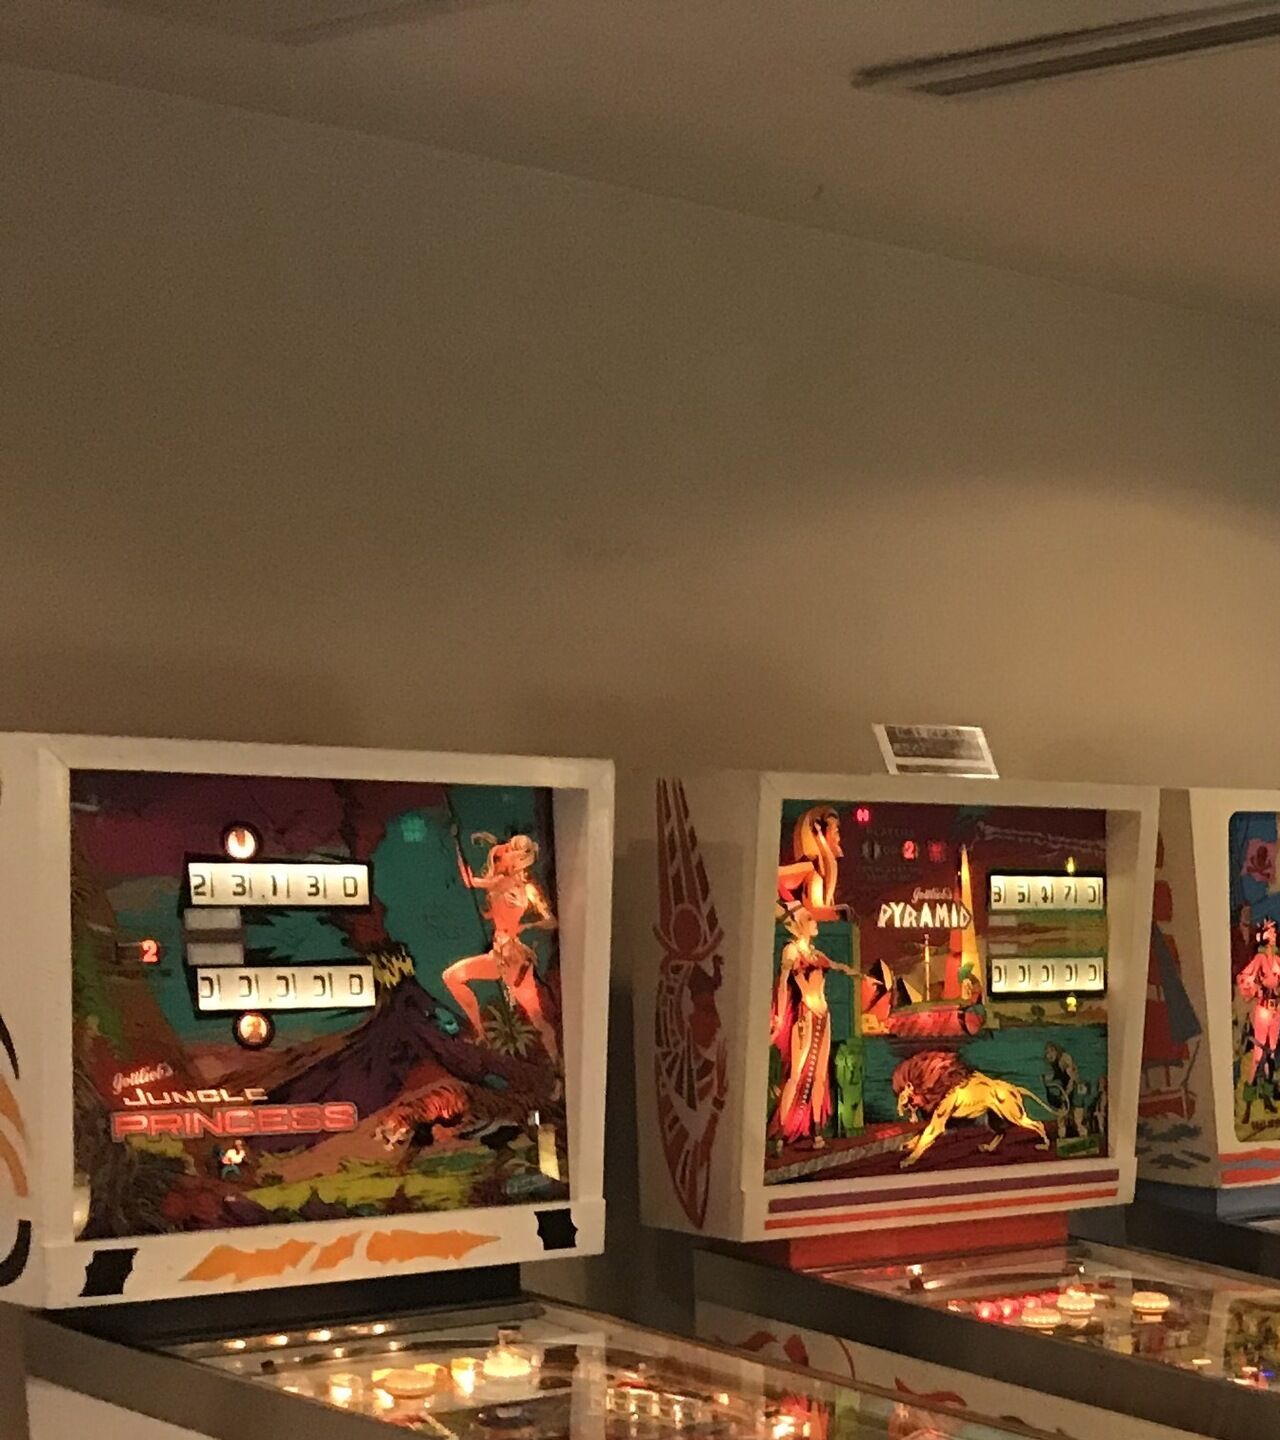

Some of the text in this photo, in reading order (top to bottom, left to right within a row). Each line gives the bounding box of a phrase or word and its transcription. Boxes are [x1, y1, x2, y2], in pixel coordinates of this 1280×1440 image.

[877, 901, 973, 929] PYRAMID
[122, 1088, 269, 1107] JUNGLE
[113, 1102, 357, 1140] PRINCESS
